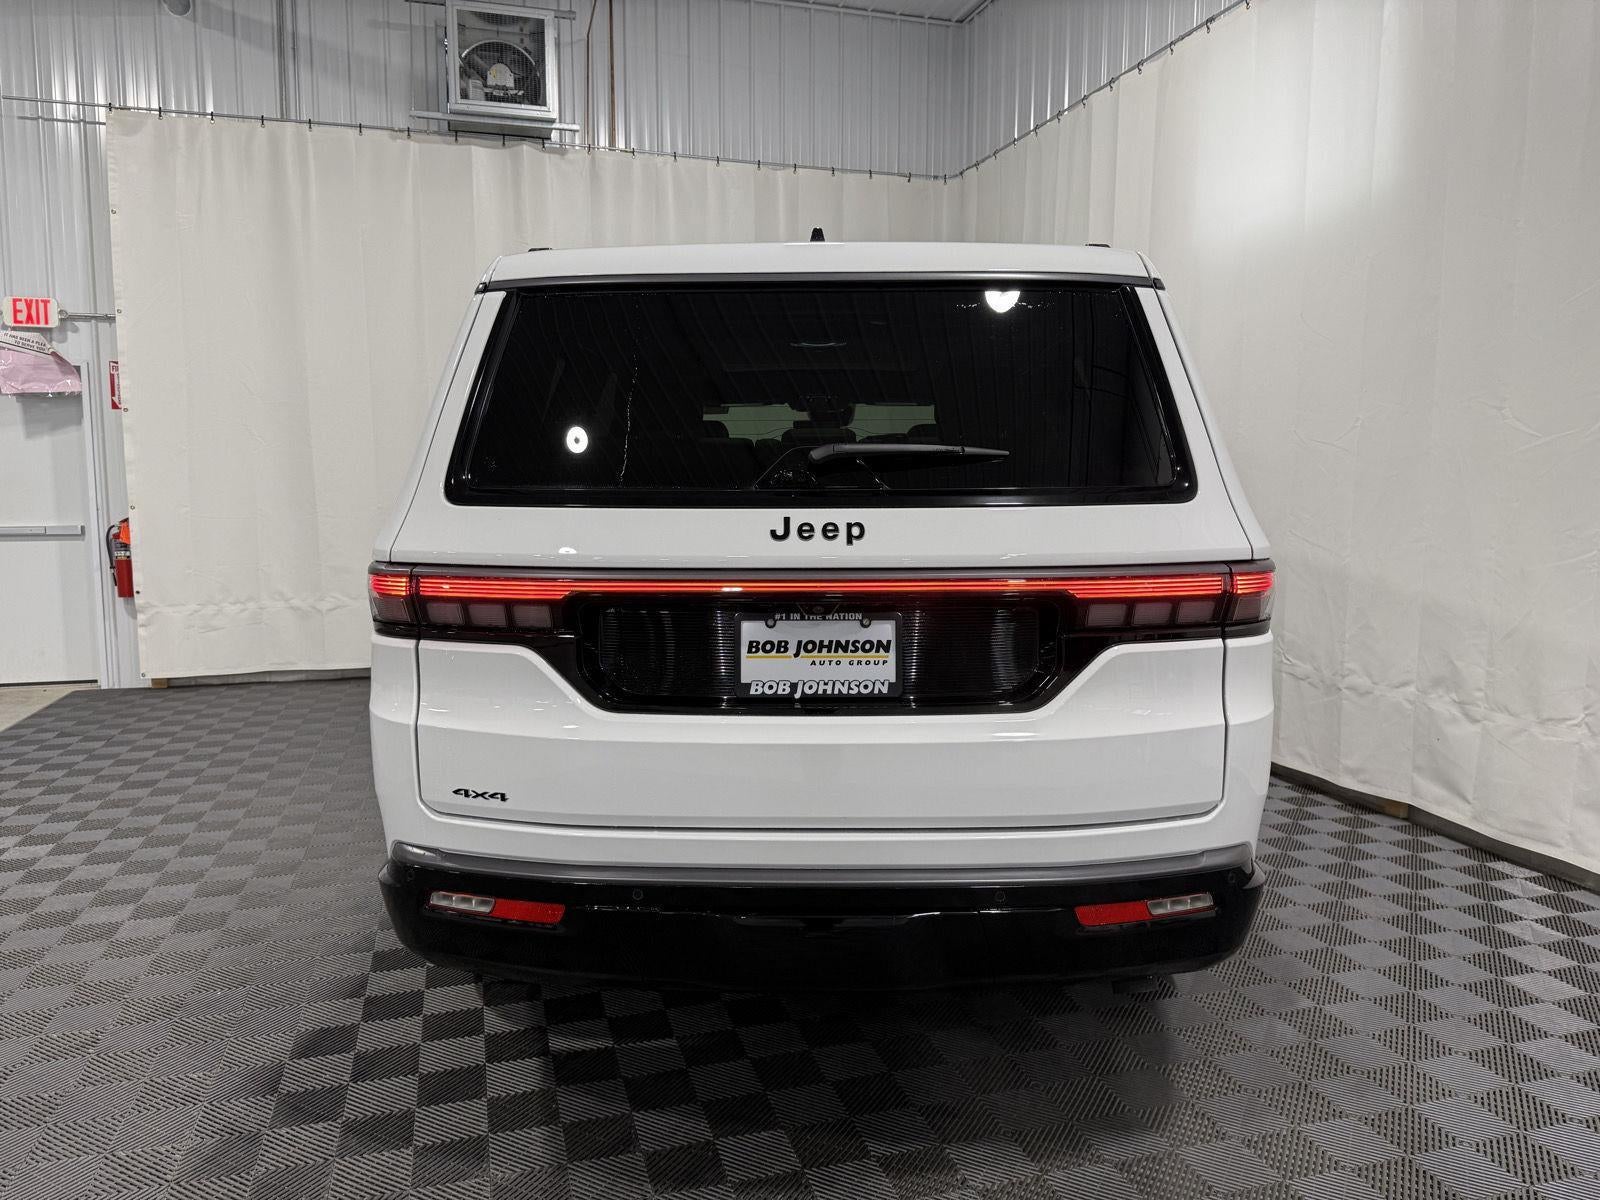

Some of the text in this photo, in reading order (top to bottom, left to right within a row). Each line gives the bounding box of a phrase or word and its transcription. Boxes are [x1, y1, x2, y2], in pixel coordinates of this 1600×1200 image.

[12, 298, 50, 325] EXIT
[770, 516, 865, 546] Jeep
[826, 612, 863, 620] NATION
[746, 639, 892, 659] BOB JOHNSON
[750, 680, 889, 699] BOB JOHNSON
[452, 788, 509, 802] 4x4
